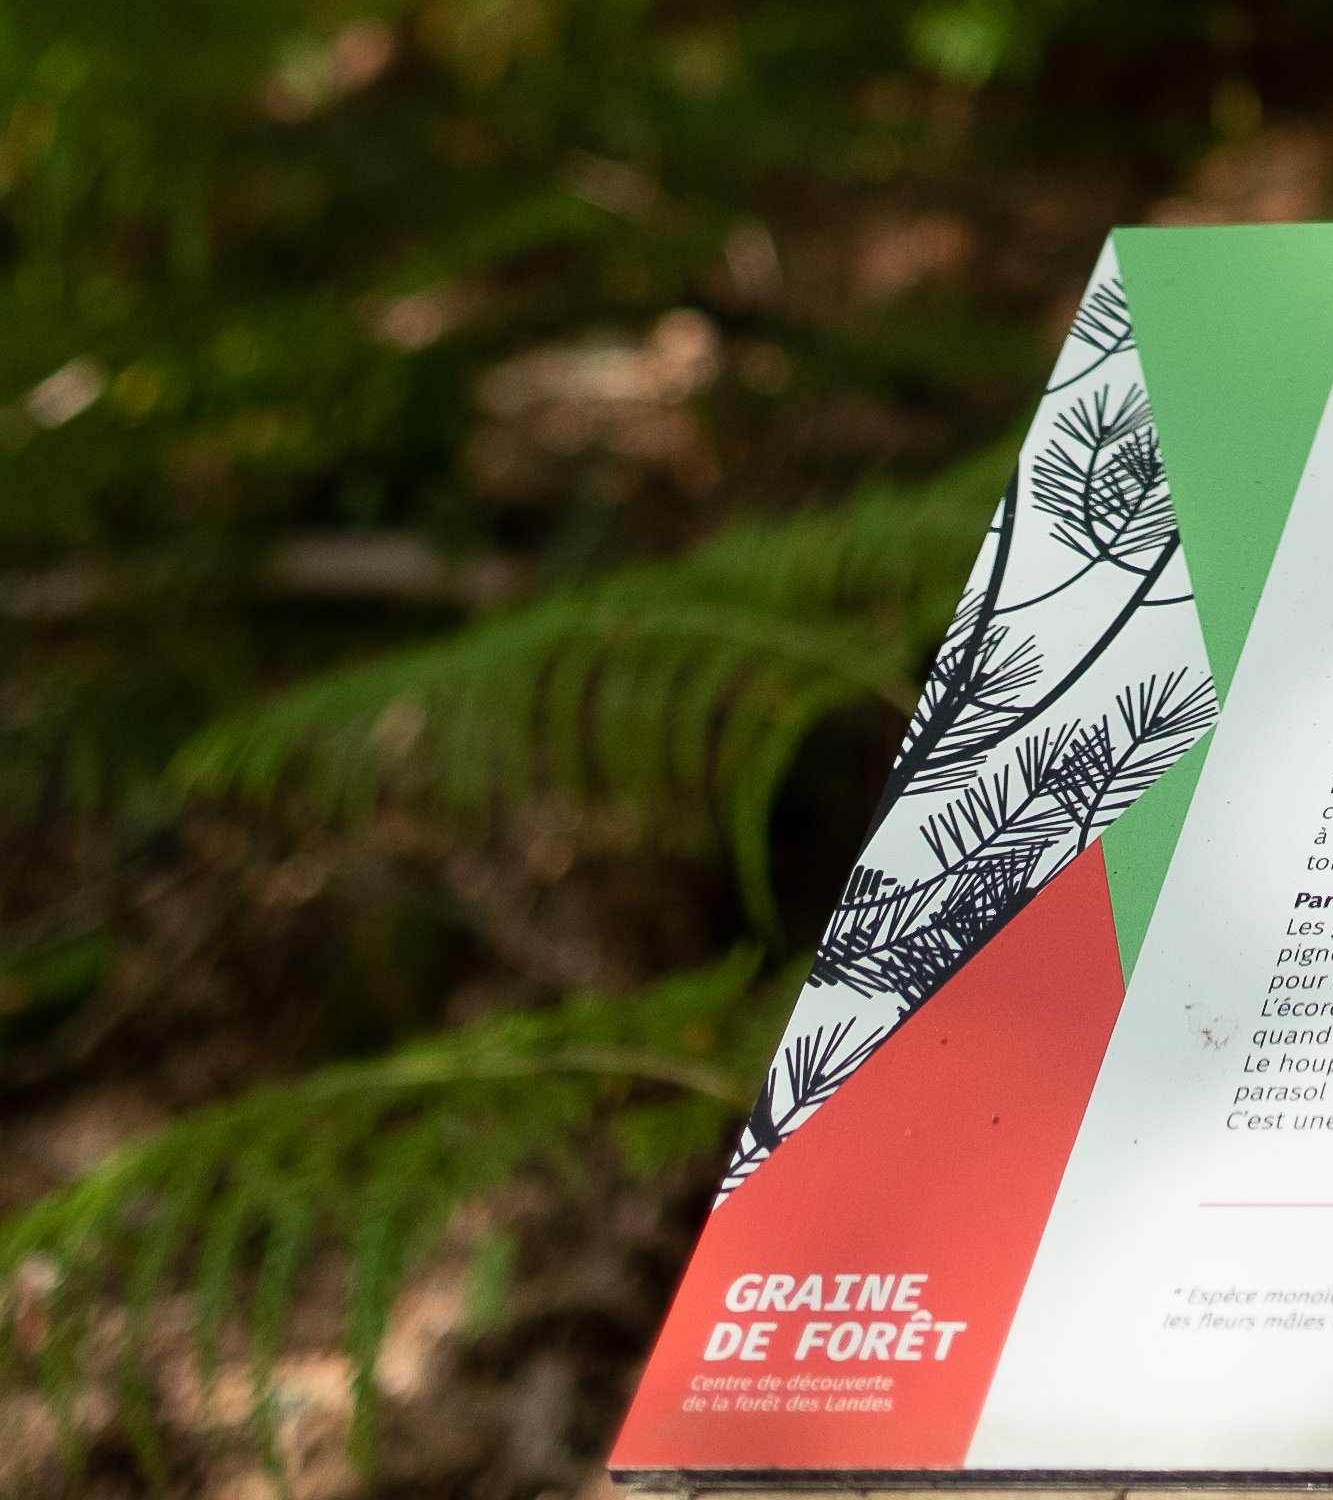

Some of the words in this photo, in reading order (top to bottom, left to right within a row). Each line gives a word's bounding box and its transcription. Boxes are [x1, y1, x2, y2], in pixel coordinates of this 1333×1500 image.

[1313, 826, 1328, 845] à
[1285, 918, 1325, 936] Les
[1267, 975, 1329, 995] pour
[1252, 1025, 1333, 1049] quand
[725, 1273, 929, 1312] GRAINE
[703, 1321, 778, 1361] DE
[794, 1309, 968, 1361] FORÊT
[691, 1374, 752, 1392] Centre
[757, 1374, 783, 1392] de
[786, 1374, 894, 1392] découverte
[683, 1395, 706, 1412] de
[711, 1395, 730, 1412] la
[735, 1393, 781, 1412] forêt
[785, 1395, 819, 1412] des
[823, 1395, 894, 1412] Landes
